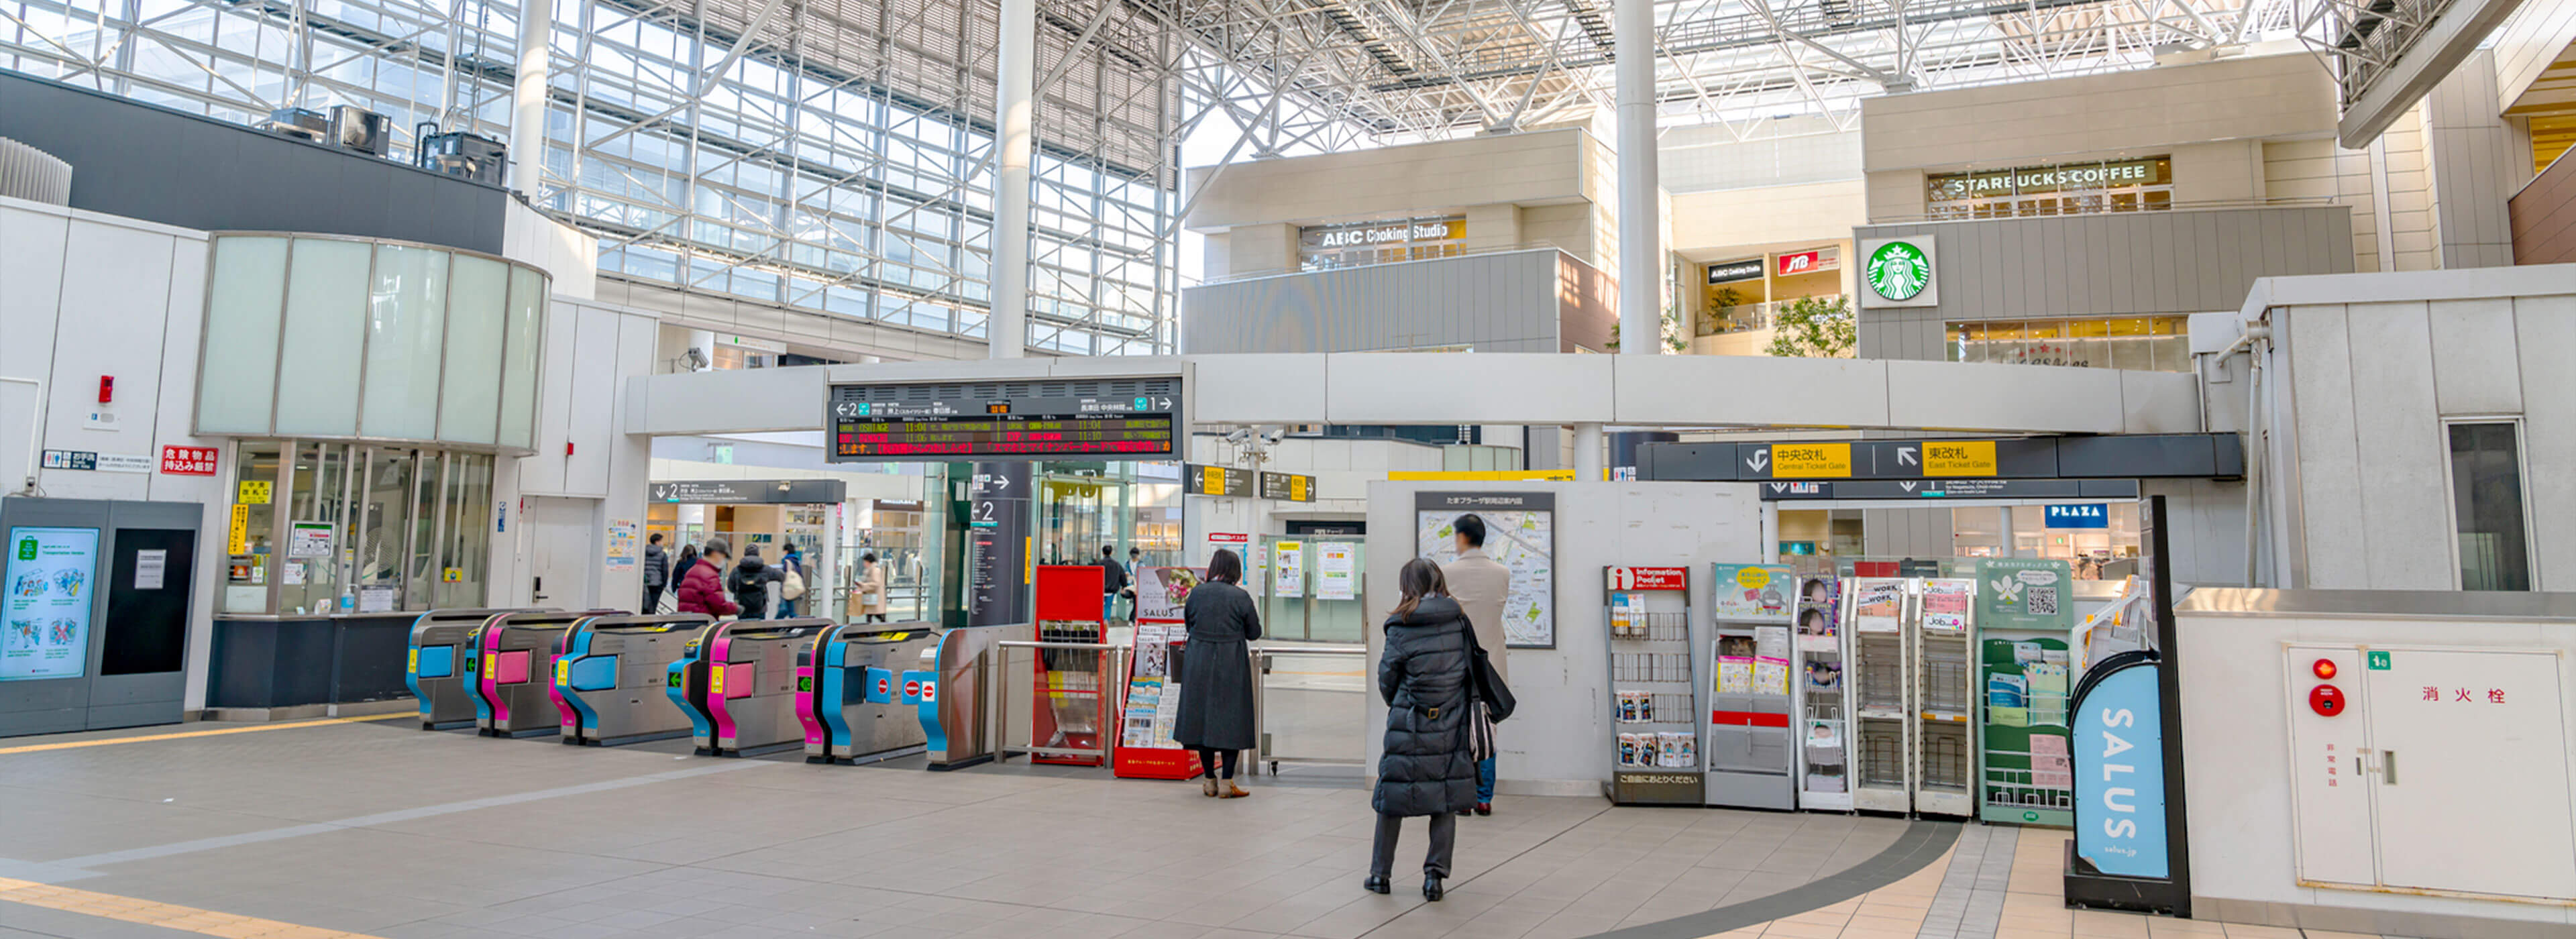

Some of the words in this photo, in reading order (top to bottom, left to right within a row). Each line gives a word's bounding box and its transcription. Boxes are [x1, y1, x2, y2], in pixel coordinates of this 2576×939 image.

[1955, 171, 2067, 192] STARBUCKS
[2072, 165, 2145, 183] COFFEE
[1322, 230, 1364, 247] ABC
[1366, 227, 1409, 242] Cooking
[1413, 223, 1448, 239] Studio
[1786, 256, 1809, 273] JTB
[849, 402, 857, 416] 2
[1151, 397, 1156, 410] 1
[164, 449, 216, 461] 危険物品
[1777, 448, 1827, 461] 中央改札
[1928, 447, 1969, 459] 東改札
[1777, 461, 1805, 470] Central
[1805, 461, 1827, 470] Ticket
[1828, 461, 1846, 470] Gate
[1928, 460, 1947, 469] East
[1948, 460, 1971, 469] Ticket
[1972, 459, 1991, 469] Gate
[670, 483, 678, 498] 2
[981, 501, 994, 521] 2
[2051, 506, 2100, 517] PLAZA
[1636, 567, 1681, 575] Information
[1874, 584, 1898, 592] WORK
[1869, 594, 1892, 603] WORK
[1143, 608, 1175, 617] SALUS
[2422, 685, 2506, 704] 消火栓
[2326, 743, 2338, 787] 非常電話
[2102, 707, 2137, 840] SALUS
[2104, 846, 2137, 858] salus.jp
